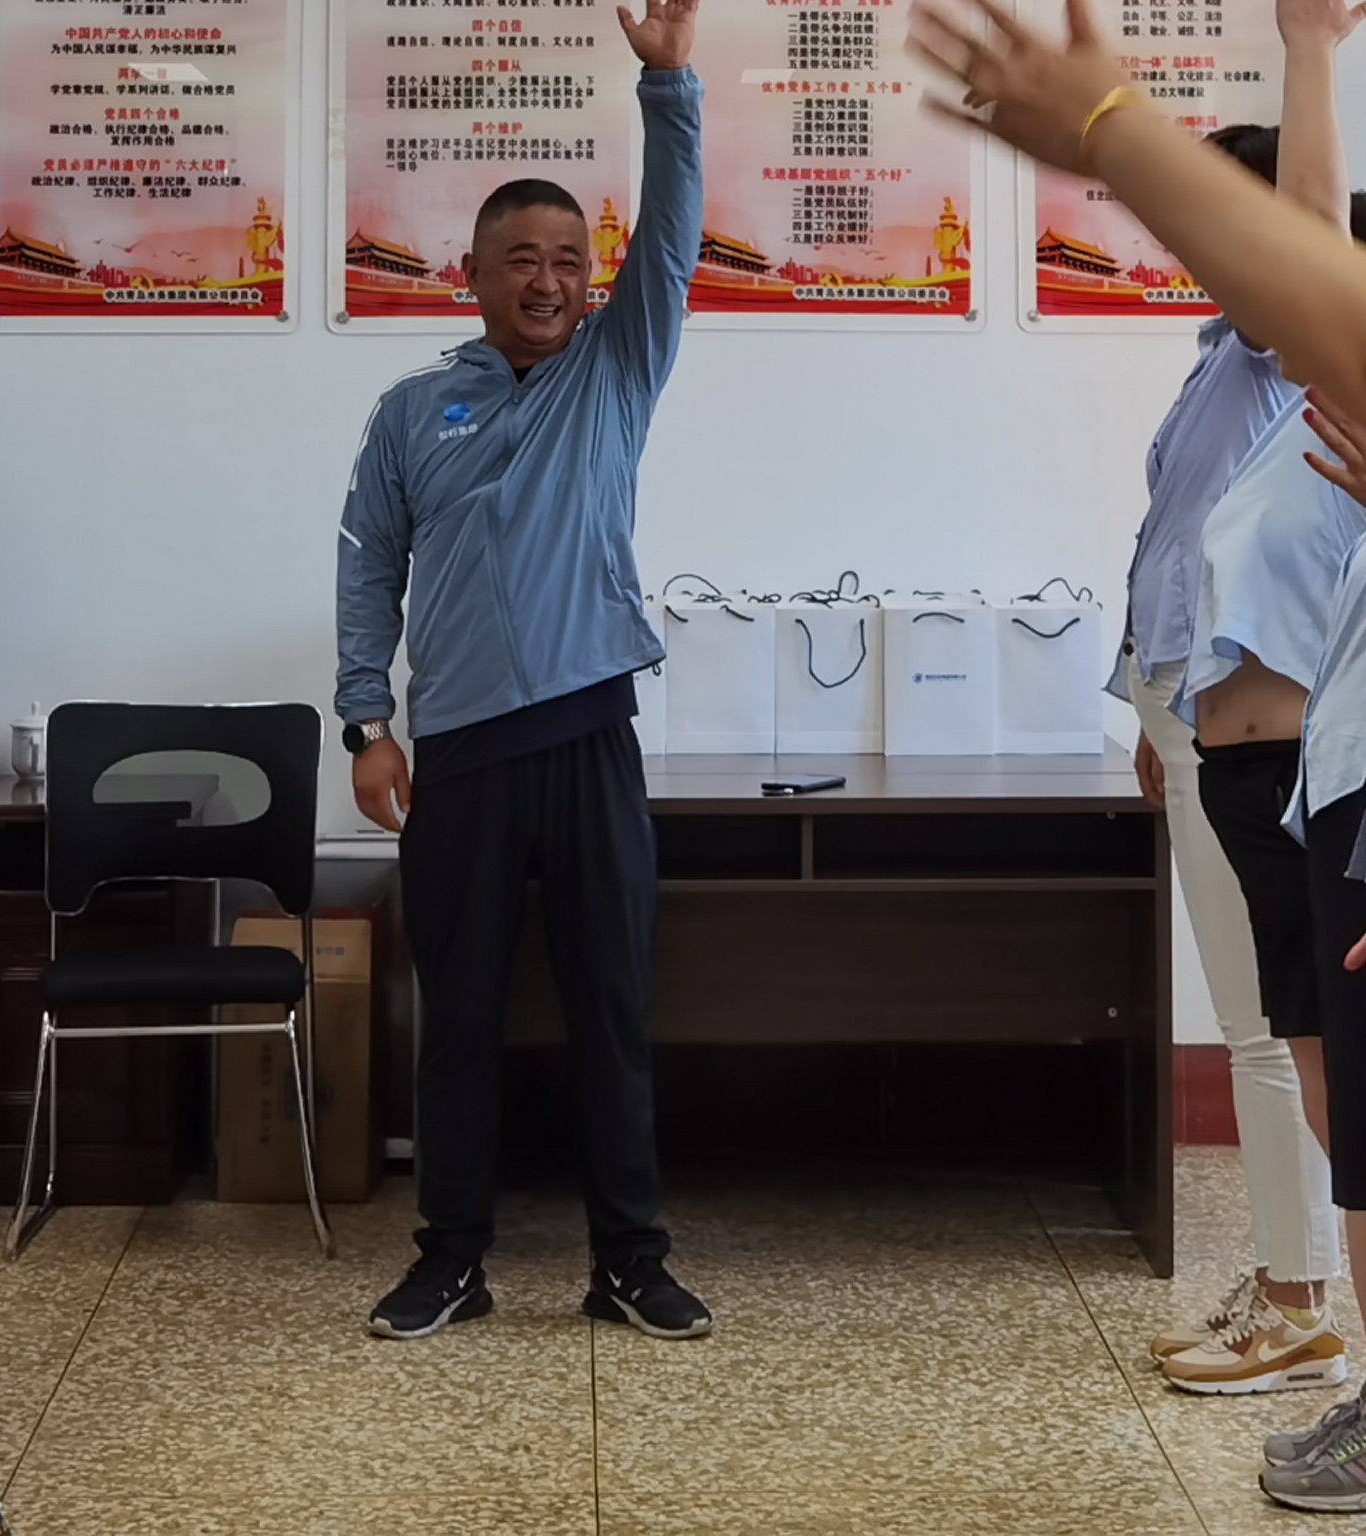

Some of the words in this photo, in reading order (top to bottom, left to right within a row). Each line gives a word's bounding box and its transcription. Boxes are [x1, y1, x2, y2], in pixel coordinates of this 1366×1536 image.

[1122, 11, 1222, 22] 自由、平等、公正、法治
[471, 19, 522, 32] 四个自信
[1122, 26, 1222, 37] 爱国、敬业、诚信、友善
[65, 27, 222, 40] 中国共产党人的初心和使命
[471, 59, 522, 72] 四个服从
[104, 107, 181, 120] 党员四个合格
[471, 121, 523, 135] 两个维护
[110, 135, 176, 147] 发挥作用合格
[386, 161, 418, 172] 一领导
